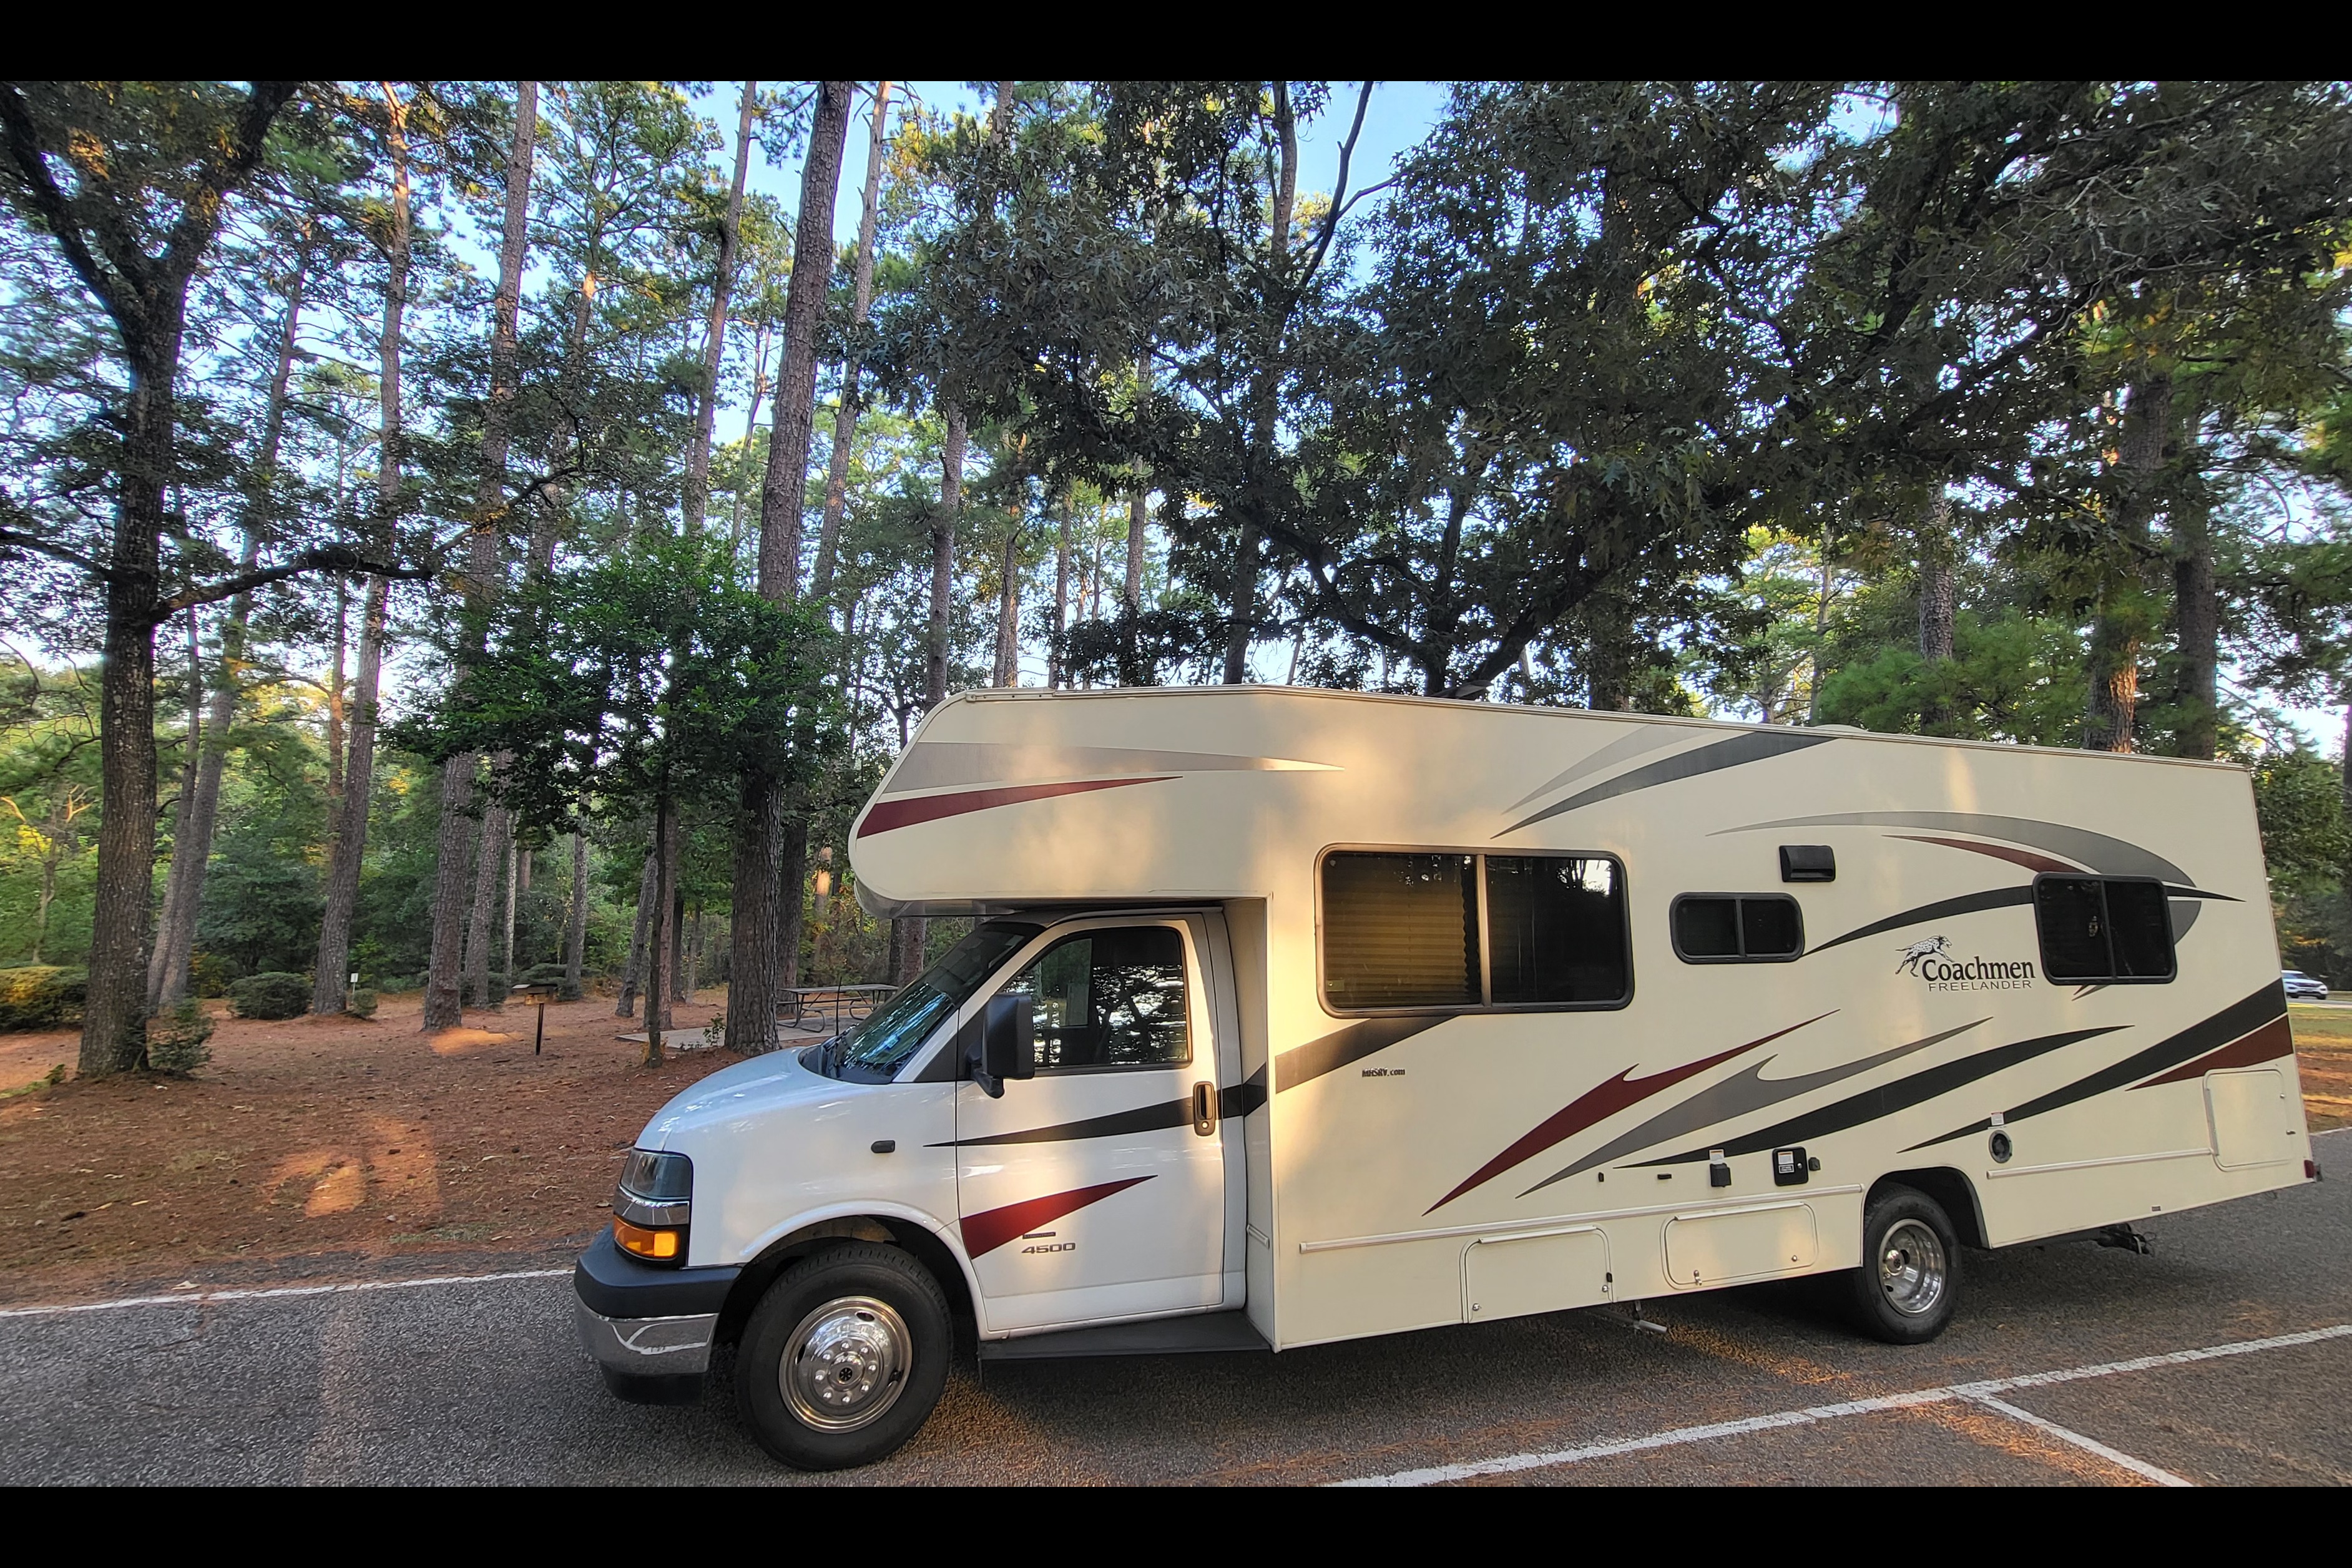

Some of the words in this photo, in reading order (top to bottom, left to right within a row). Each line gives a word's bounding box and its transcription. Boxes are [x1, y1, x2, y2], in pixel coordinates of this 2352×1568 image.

[1921, 956, 2036, 982] Coachmen
[1928, 980, 2032, 992] FREELANDER
[1021, 1242, 1076, 1254] 4500
